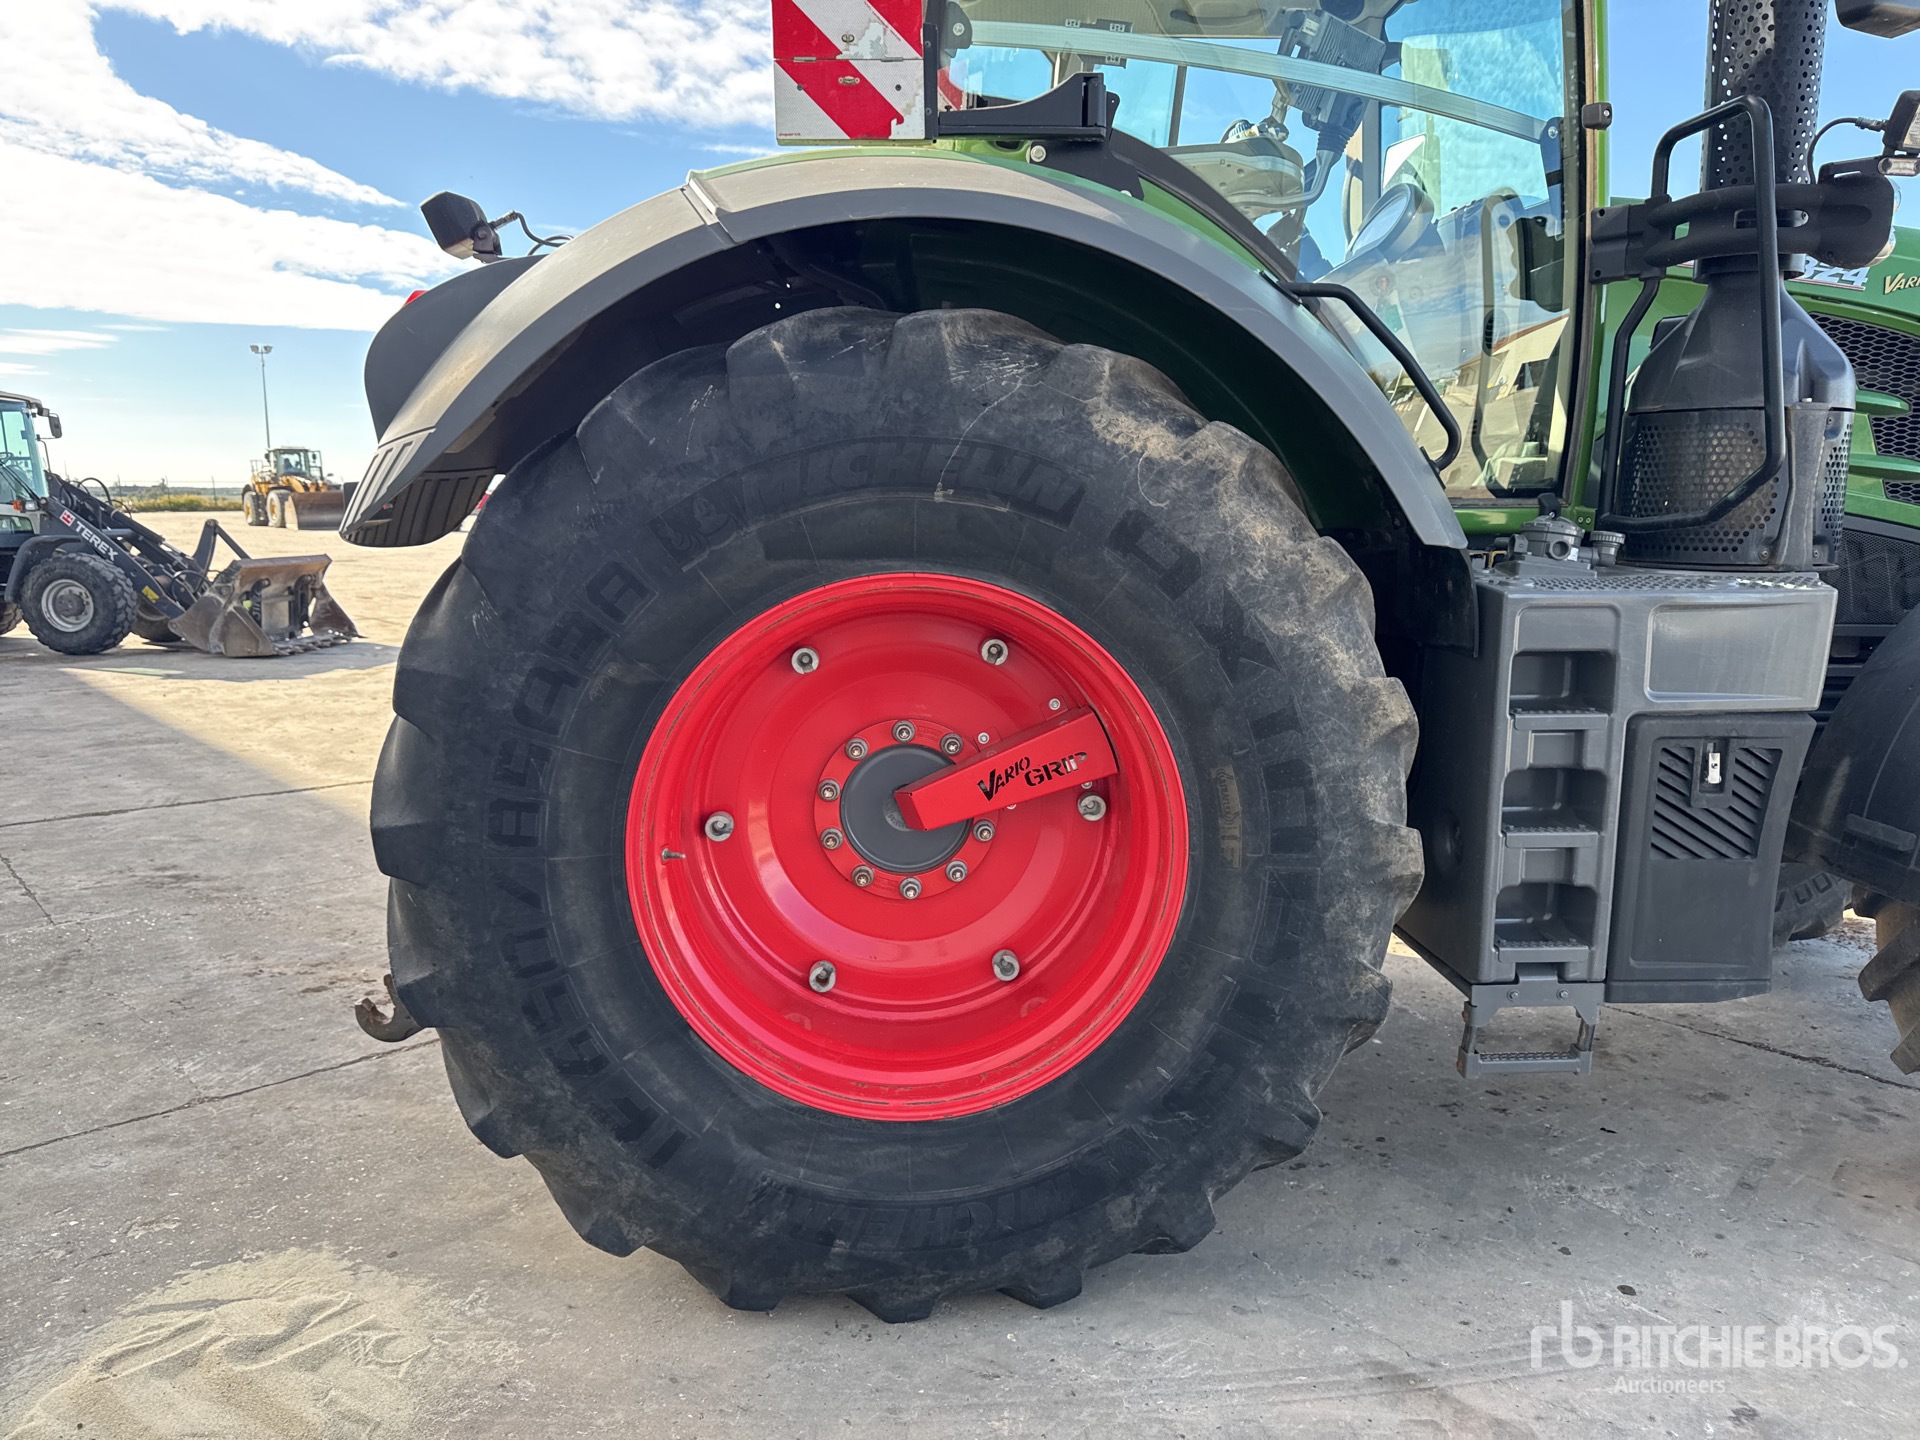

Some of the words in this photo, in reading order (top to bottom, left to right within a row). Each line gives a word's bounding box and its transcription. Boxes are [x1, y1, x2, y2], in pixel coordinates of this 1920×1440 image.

[742, 439, 1077, 516] MICHELIN
[75, 521, 119, 561] TEREX
[977, 756, 1031, 801] VARIO
[1024, 751, 1088, 787] GRIP
